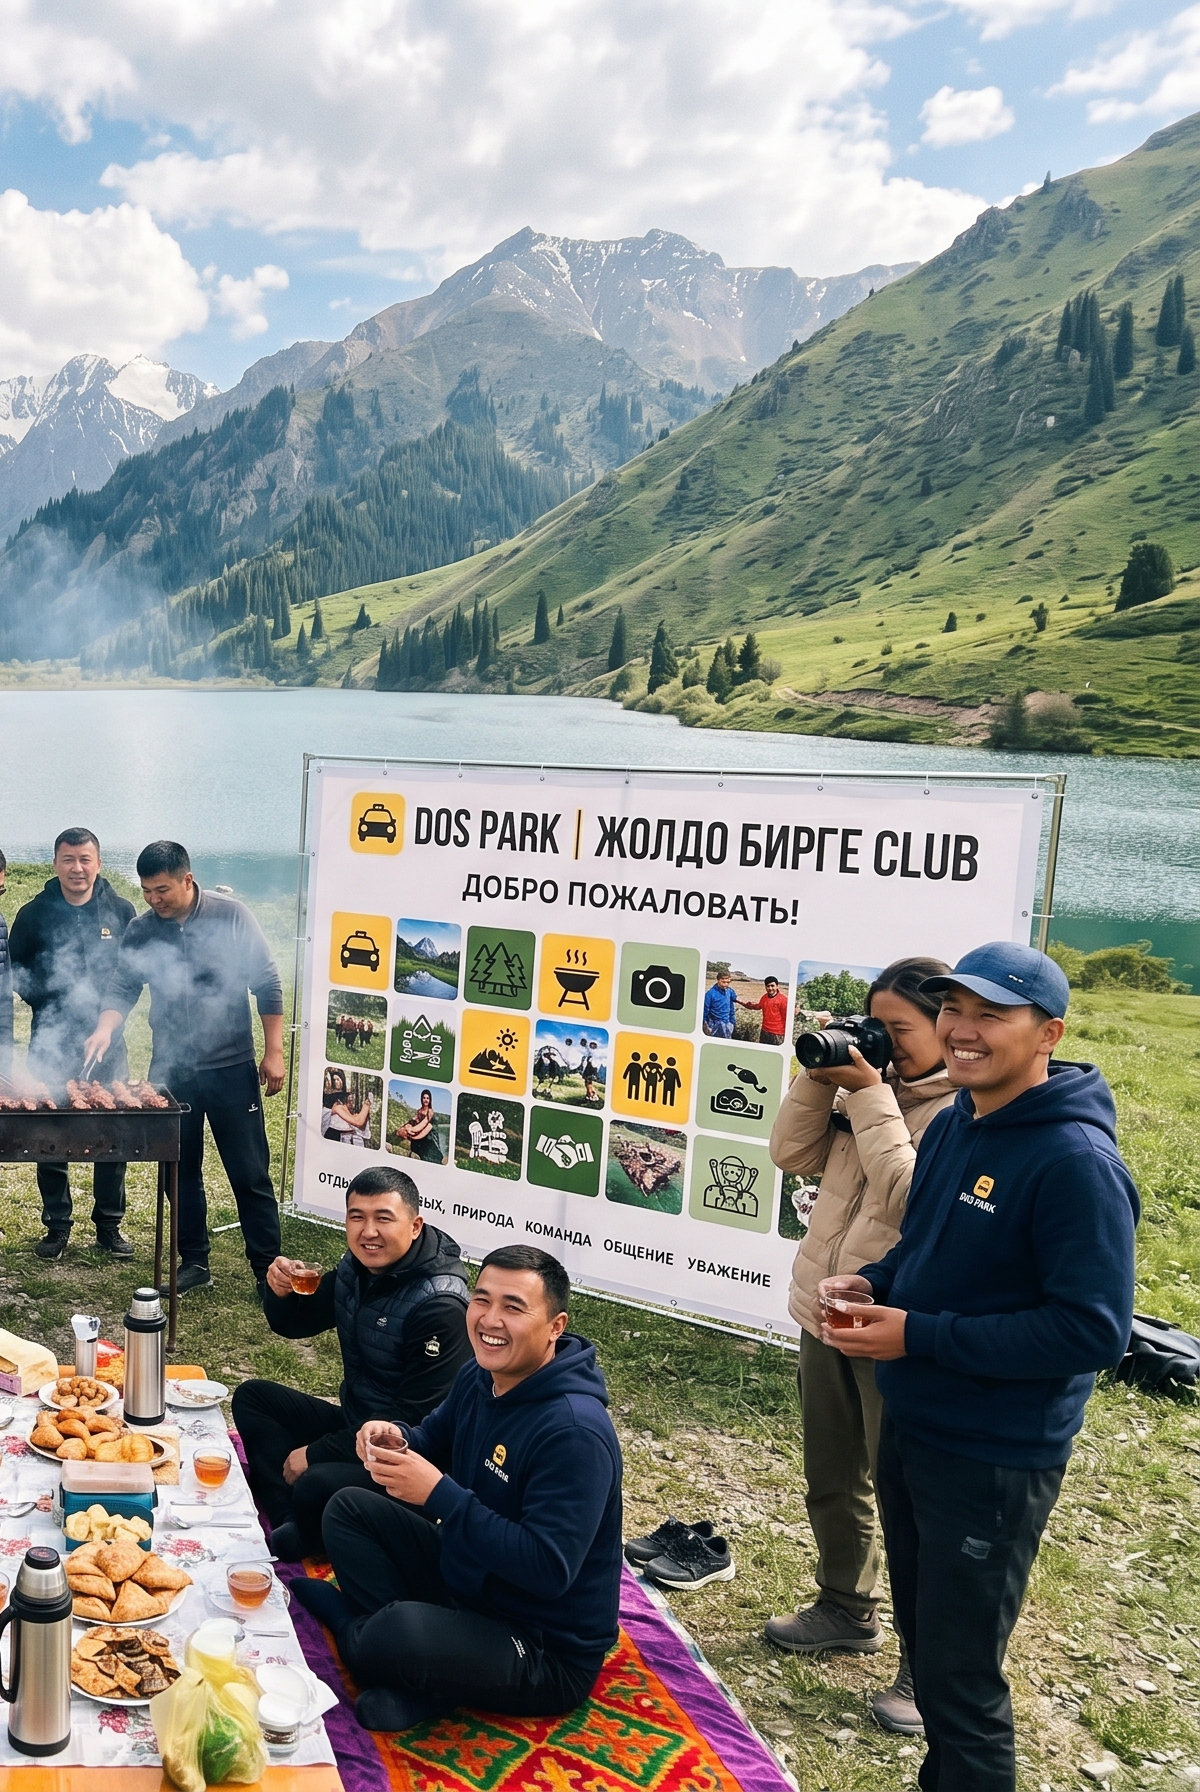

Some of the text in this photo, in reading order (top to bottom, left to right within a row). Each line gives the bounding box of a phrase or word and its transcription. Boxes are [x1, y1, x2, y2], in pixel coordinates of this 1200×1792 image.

[414, 806, 979, 882] DOS PARK ЖОЛДО БИРГЕ CLUB
[461, 873, 799, 926] ДОБРО ПОЖАЛОВАТЬ!
[452, 1203, 515, 1229] ПРИРОДА
[525, 1220, 592, 1247] КОМАНДА
[603, 1238, 674, 1266] ОБЩЕНИЕ
[687, 1256, 771, 1288] УВАЖЕНИЕ
